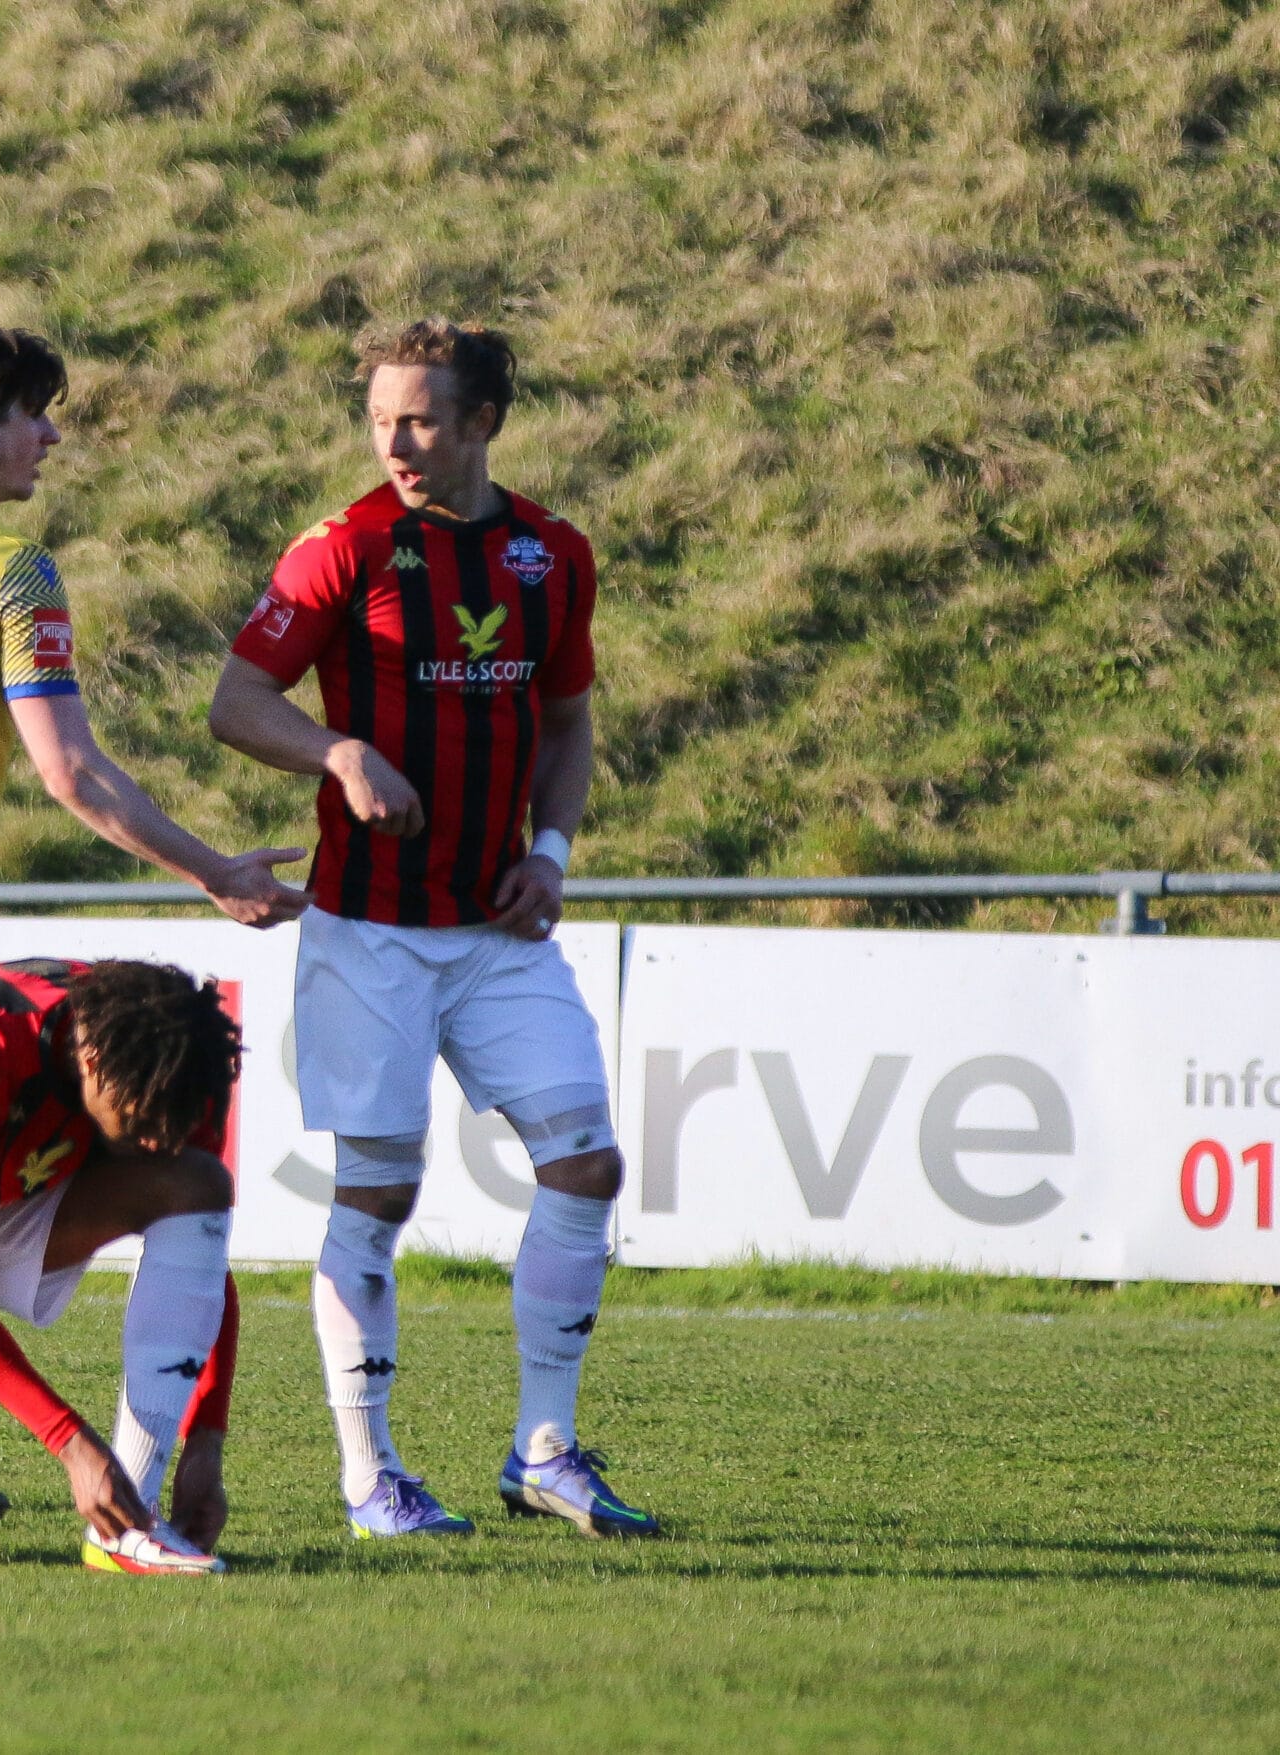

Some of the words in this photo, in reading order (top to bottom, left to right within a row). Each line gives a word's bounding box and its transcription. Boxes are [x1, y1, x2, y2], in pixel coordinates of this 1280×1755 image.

[419, 661, 465, 681] LYLE
[480, 661, 535, 681] SCOTT
[1180, 1139, 1274, 1229] 01
